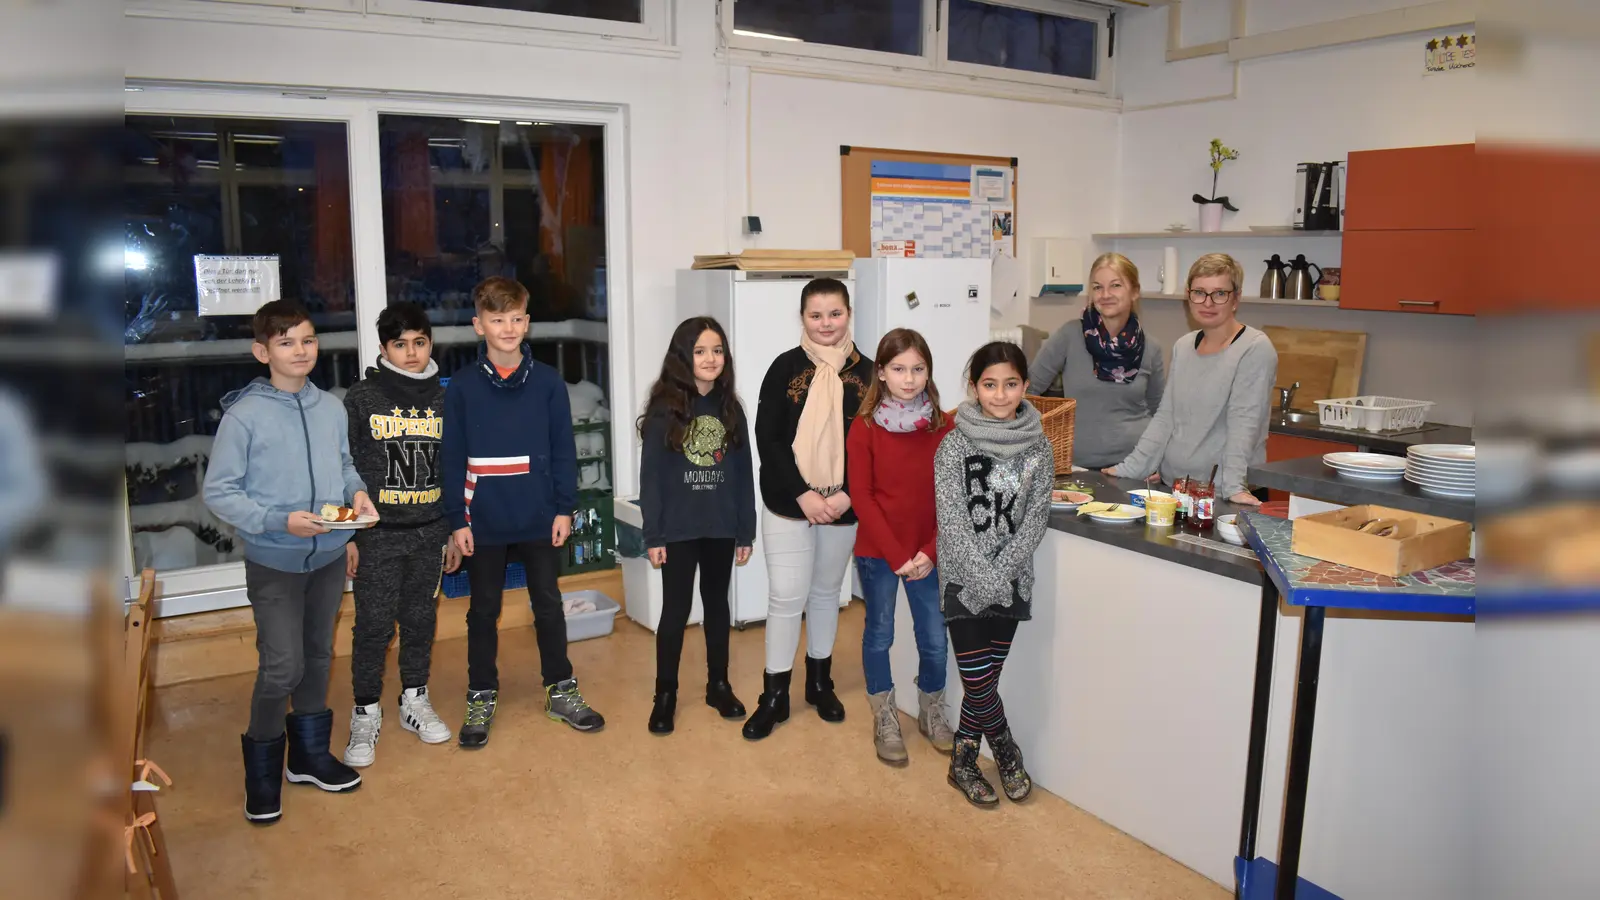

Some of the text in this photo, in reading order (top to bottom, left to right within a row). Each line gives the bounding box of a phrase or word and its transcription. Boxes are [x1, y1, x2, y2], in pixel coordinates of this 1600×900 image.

[369, 414, 443, 440] SUPERIO
[384, 440, 442, 488] NY
[683, 470, 725, 483] MONDAYS
